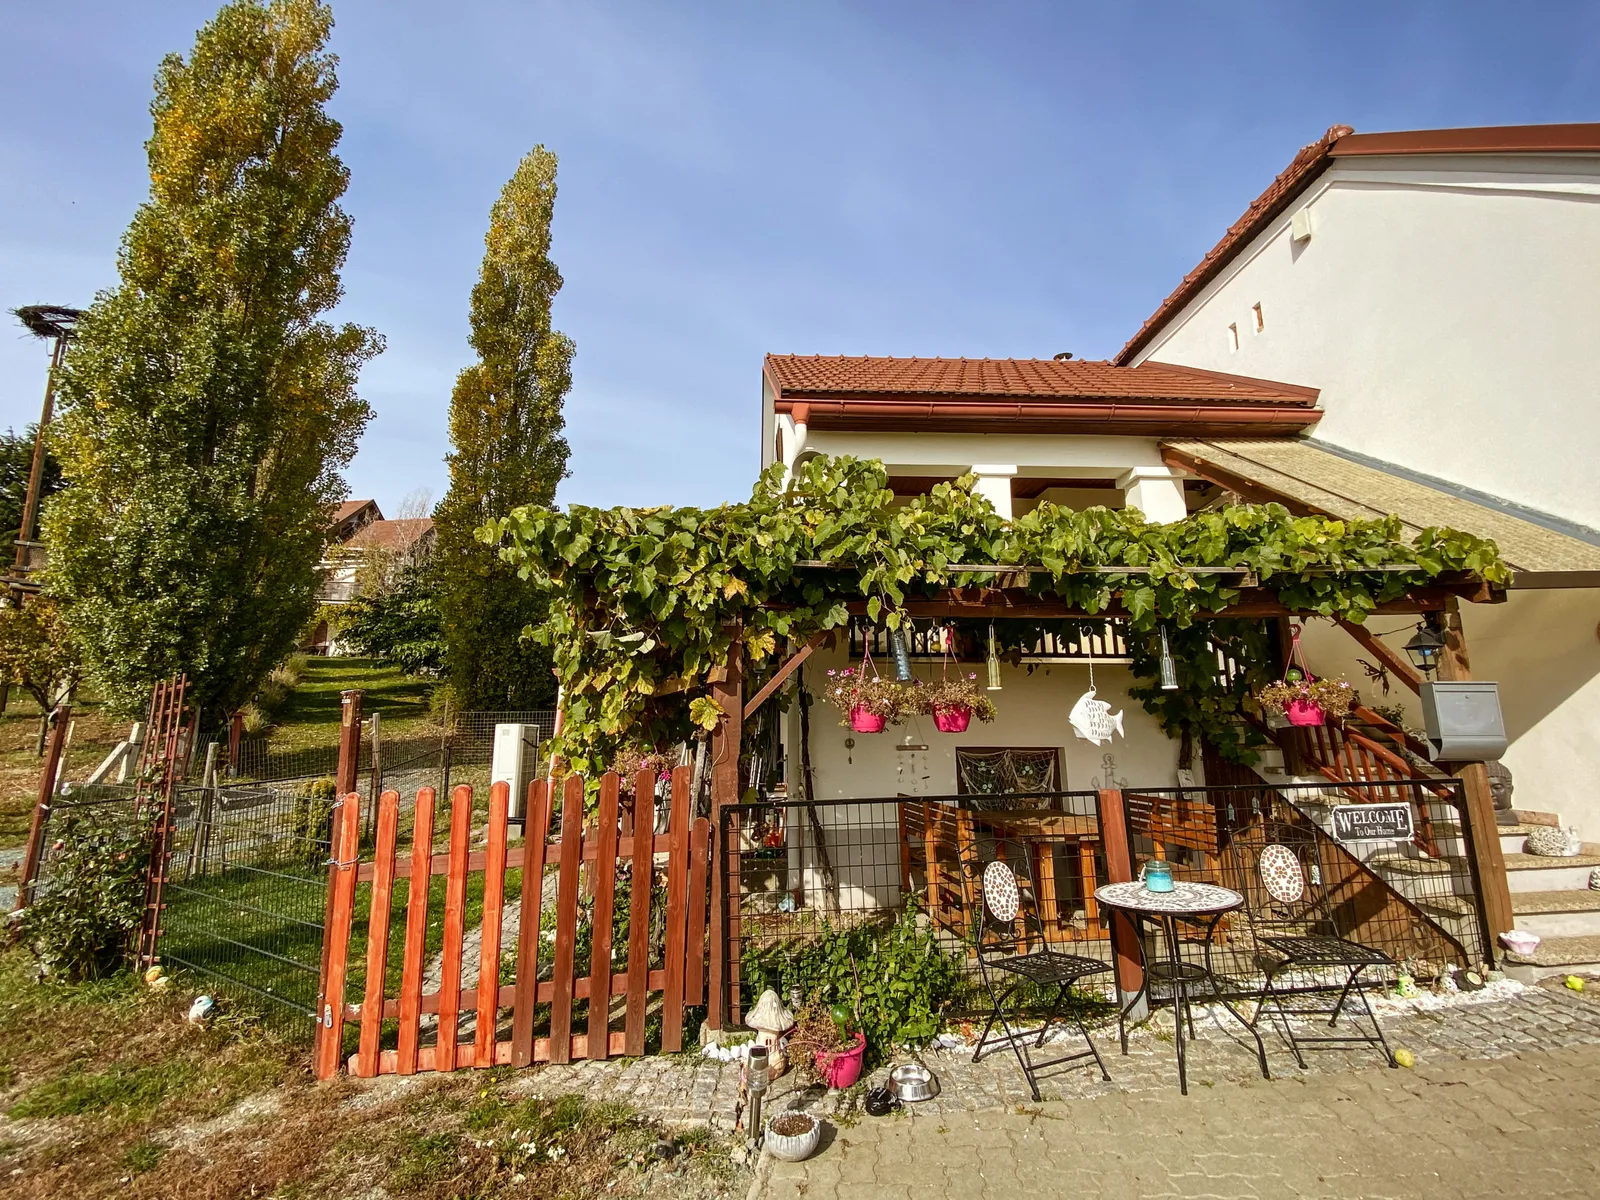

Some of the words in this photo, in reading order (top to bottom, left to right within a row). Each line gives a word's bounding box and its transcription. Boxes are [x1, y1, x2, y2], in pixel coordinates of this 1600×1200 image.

[1338, 809, 1408, 833] WELCOME
[1355, 826, 1364, 836] To
[1364, 825, 1376, 836] Our
